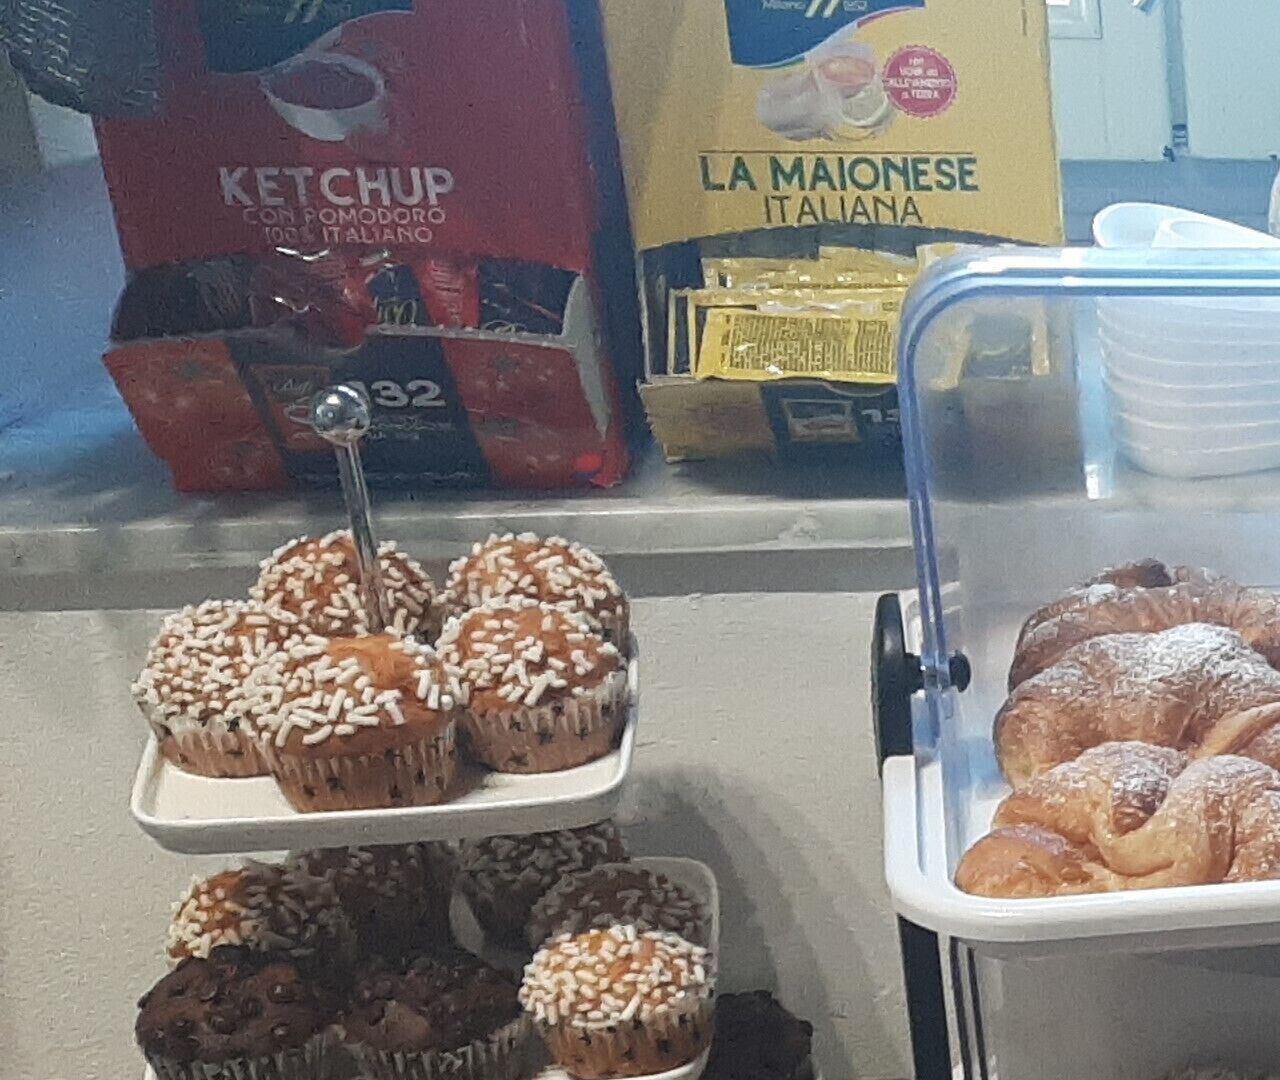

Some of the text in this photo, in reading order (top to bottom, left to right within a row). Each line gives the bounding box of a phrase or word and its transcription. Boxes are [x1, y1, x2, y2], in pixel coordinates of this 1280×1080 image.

[218, 166, 455, 207] KETCHUP
[699, 155, 980, 192] LA MAIONESE
[242, 207, 447, 226] CON POMODORO
[764, 194, 924, 225] ITALIANA
[322, 225, 433, 244] ITALIANO
